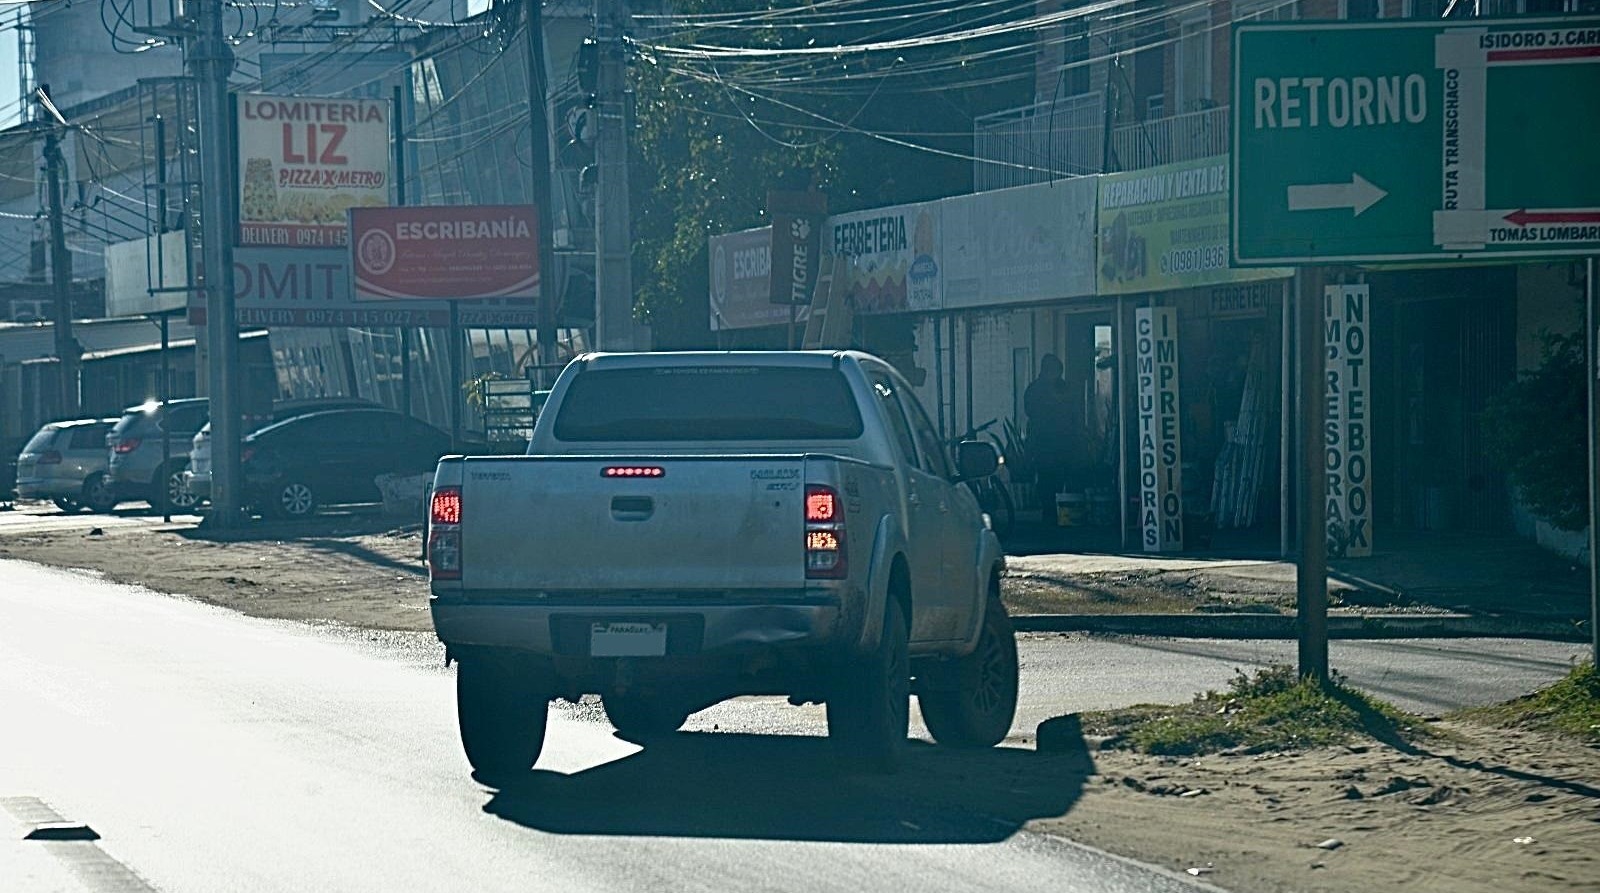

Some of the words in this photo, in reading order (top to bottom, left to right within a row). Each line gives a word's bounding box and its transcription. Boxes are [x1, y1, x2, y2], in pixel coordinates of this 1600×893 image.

[1480, 32, 1546, 49] ISIDORO
[244, 100, 384, 124] LOMITERÍA
[1254, 73, 1427, 129] RETORNO
[1446, 69, 1459, 166] TRANSCHACO
[282, 123, 348, 165] LIZ
[279, 169, 320, 187] PIZZA
[337, 170, 384, 187] METRO
[1103, 172, 1166, 208] REPARACIÓN
[1166, 172, 1174, 201] Y
[1175, 167, 1208, 200] VENTA
[1210, 164, 1225, 193] DE
[1446, 170, 1459, 210] RUTA
[241, 227, 290, 245] DELIVERY
[296, 227, 324, 245] 0974
[329, 227, 348, 245] 145
[396, 215, 530, 240] ESCRIBANÍA
[834, 215, 907, 254] FERRETERIA
[1490, 227, 1537, 241] TOMAS
[792, 243, 808, 301] TIGRE
[1170, 247, 1202, 273] (0981)
[1205, 246, 1224, 269] 936
[235, 309, 296, 324] ELIVERY
[305, 310, 345, 325] 0974
[351, 310, 379, 325] 145
[384, 310, 412, 325] 027
[1138, 318, 1157, 546] COMPUTADORAS
[1157, 314, 1181, 543] IMPRESION
[1345, 293, 1368, 548] NOTEBOOK
